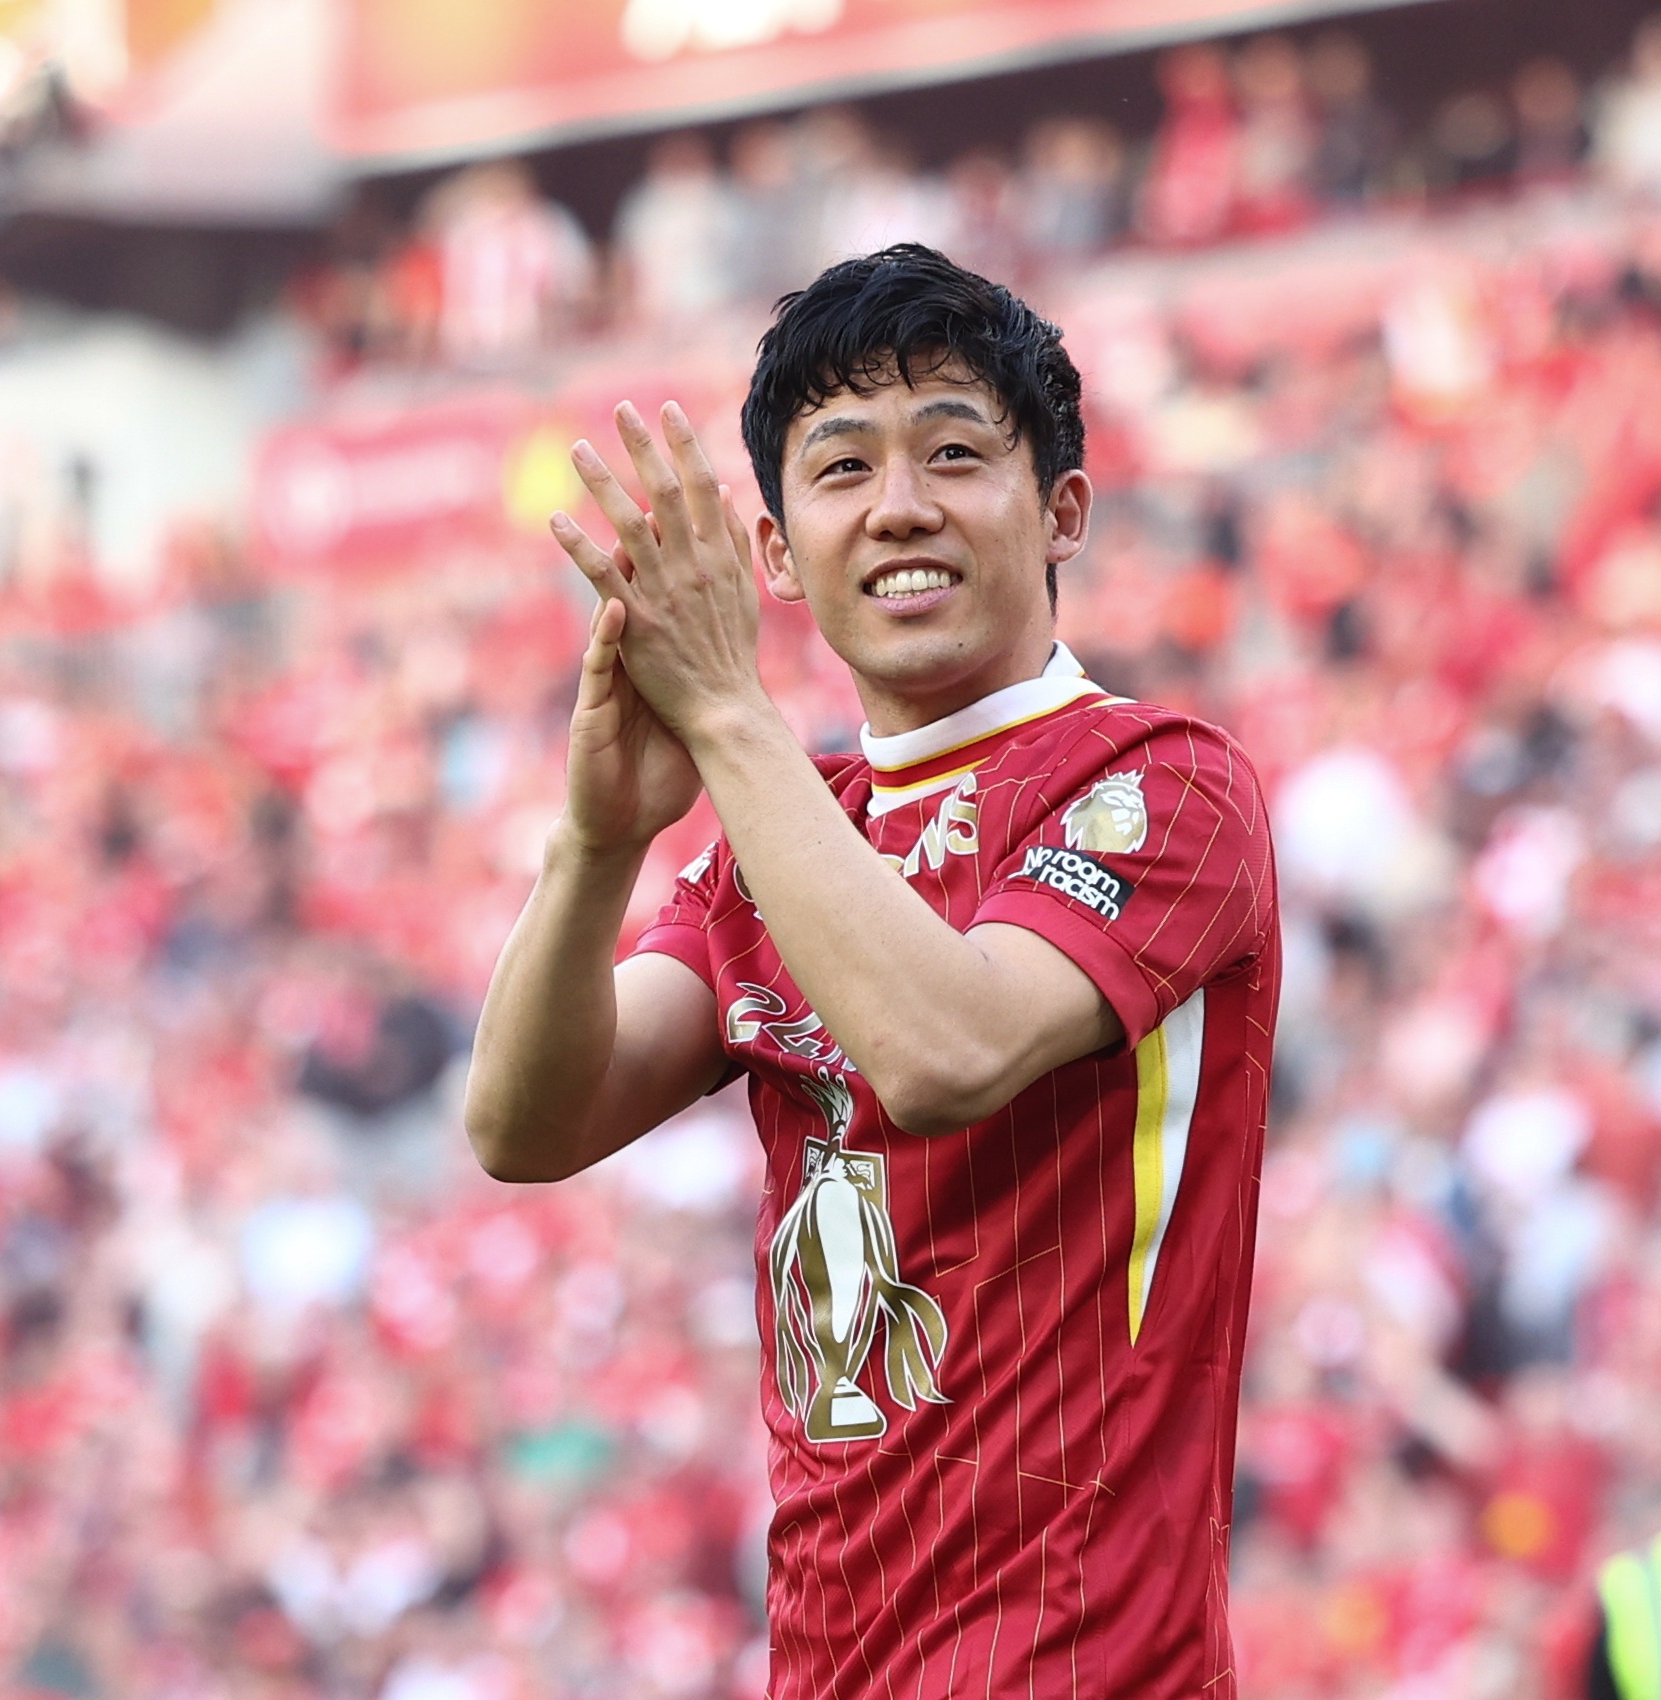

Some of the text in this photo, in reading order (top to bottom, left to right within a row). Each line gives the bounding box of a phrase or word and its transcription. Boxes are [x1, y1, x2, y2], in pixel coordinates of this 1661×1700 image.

[1023, 846, 1121, 899] No room
[1038, 864, 1120, 921] racism
